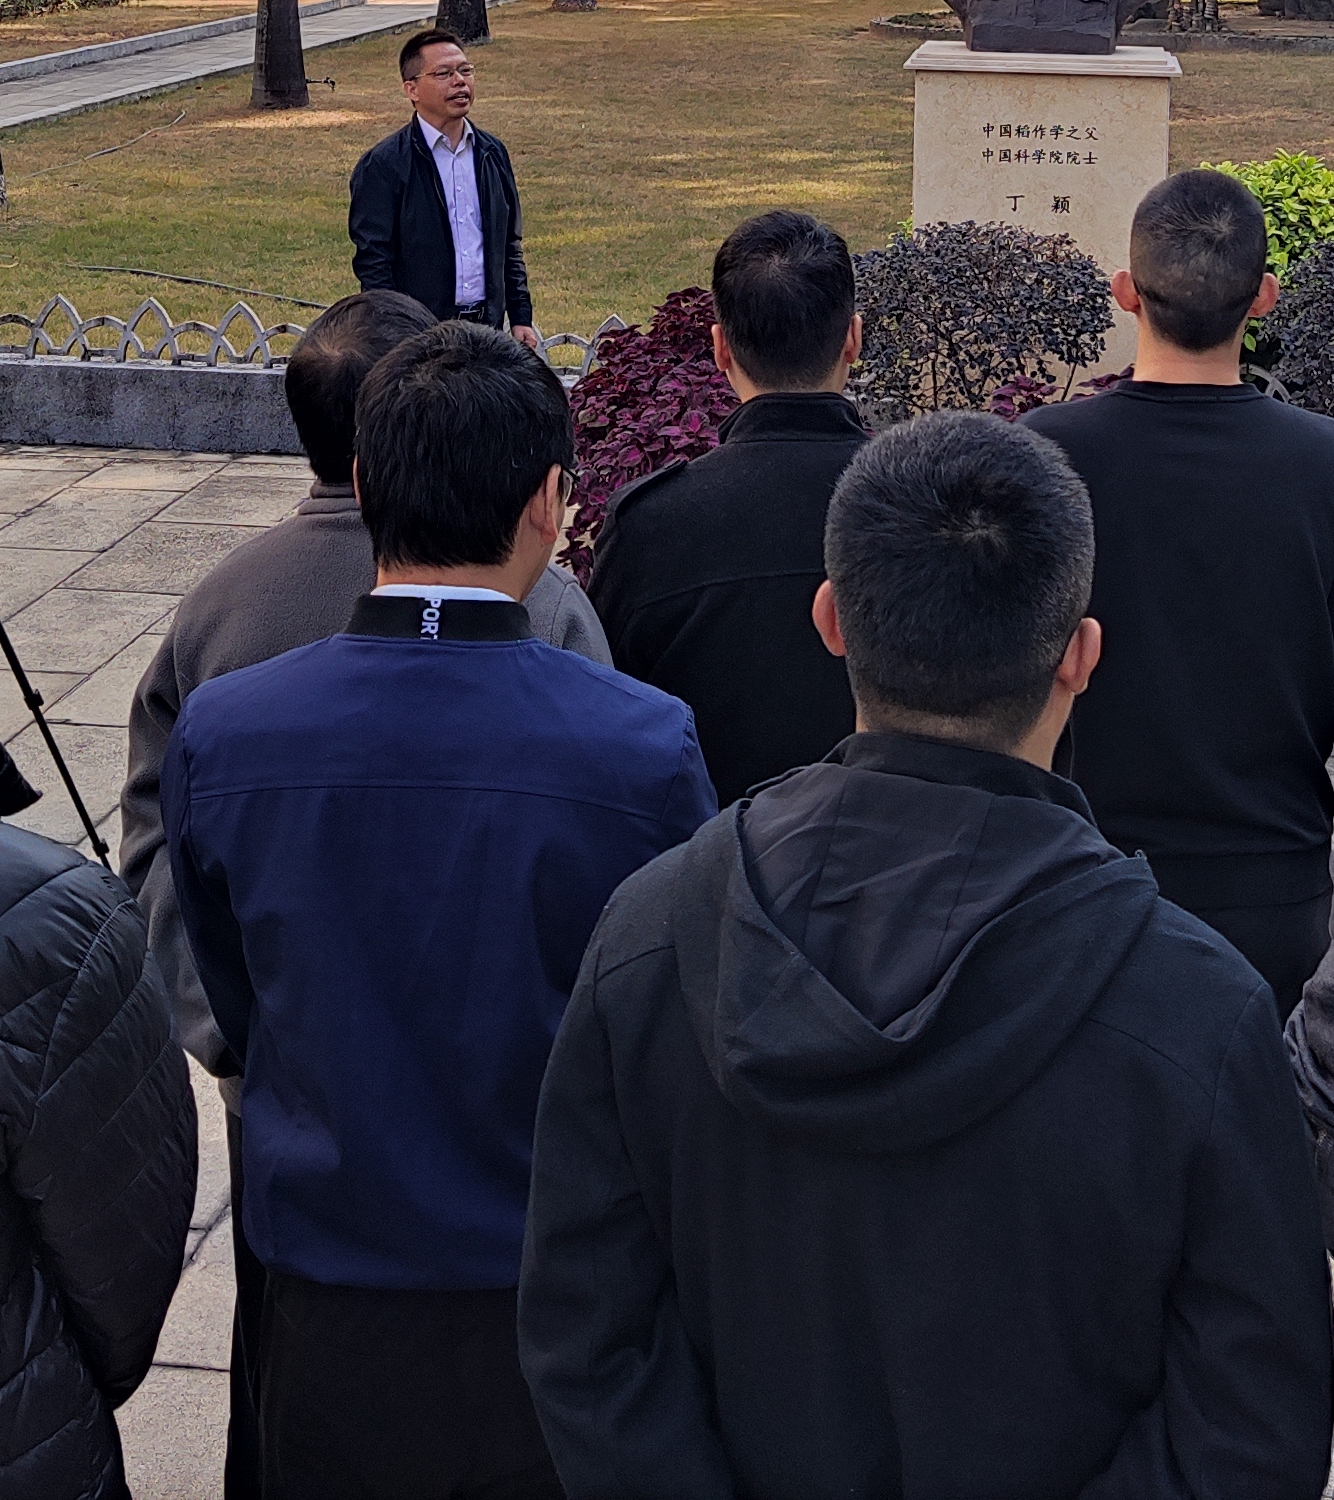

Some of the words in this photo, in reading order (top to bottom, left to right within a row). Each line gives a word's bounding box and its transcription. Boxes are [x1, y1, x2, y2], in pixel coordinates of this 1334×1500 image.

[982, 123, 1099, 141] 中国稻作学之父
[982, 147, 1098, 165] 中国科学院院士
